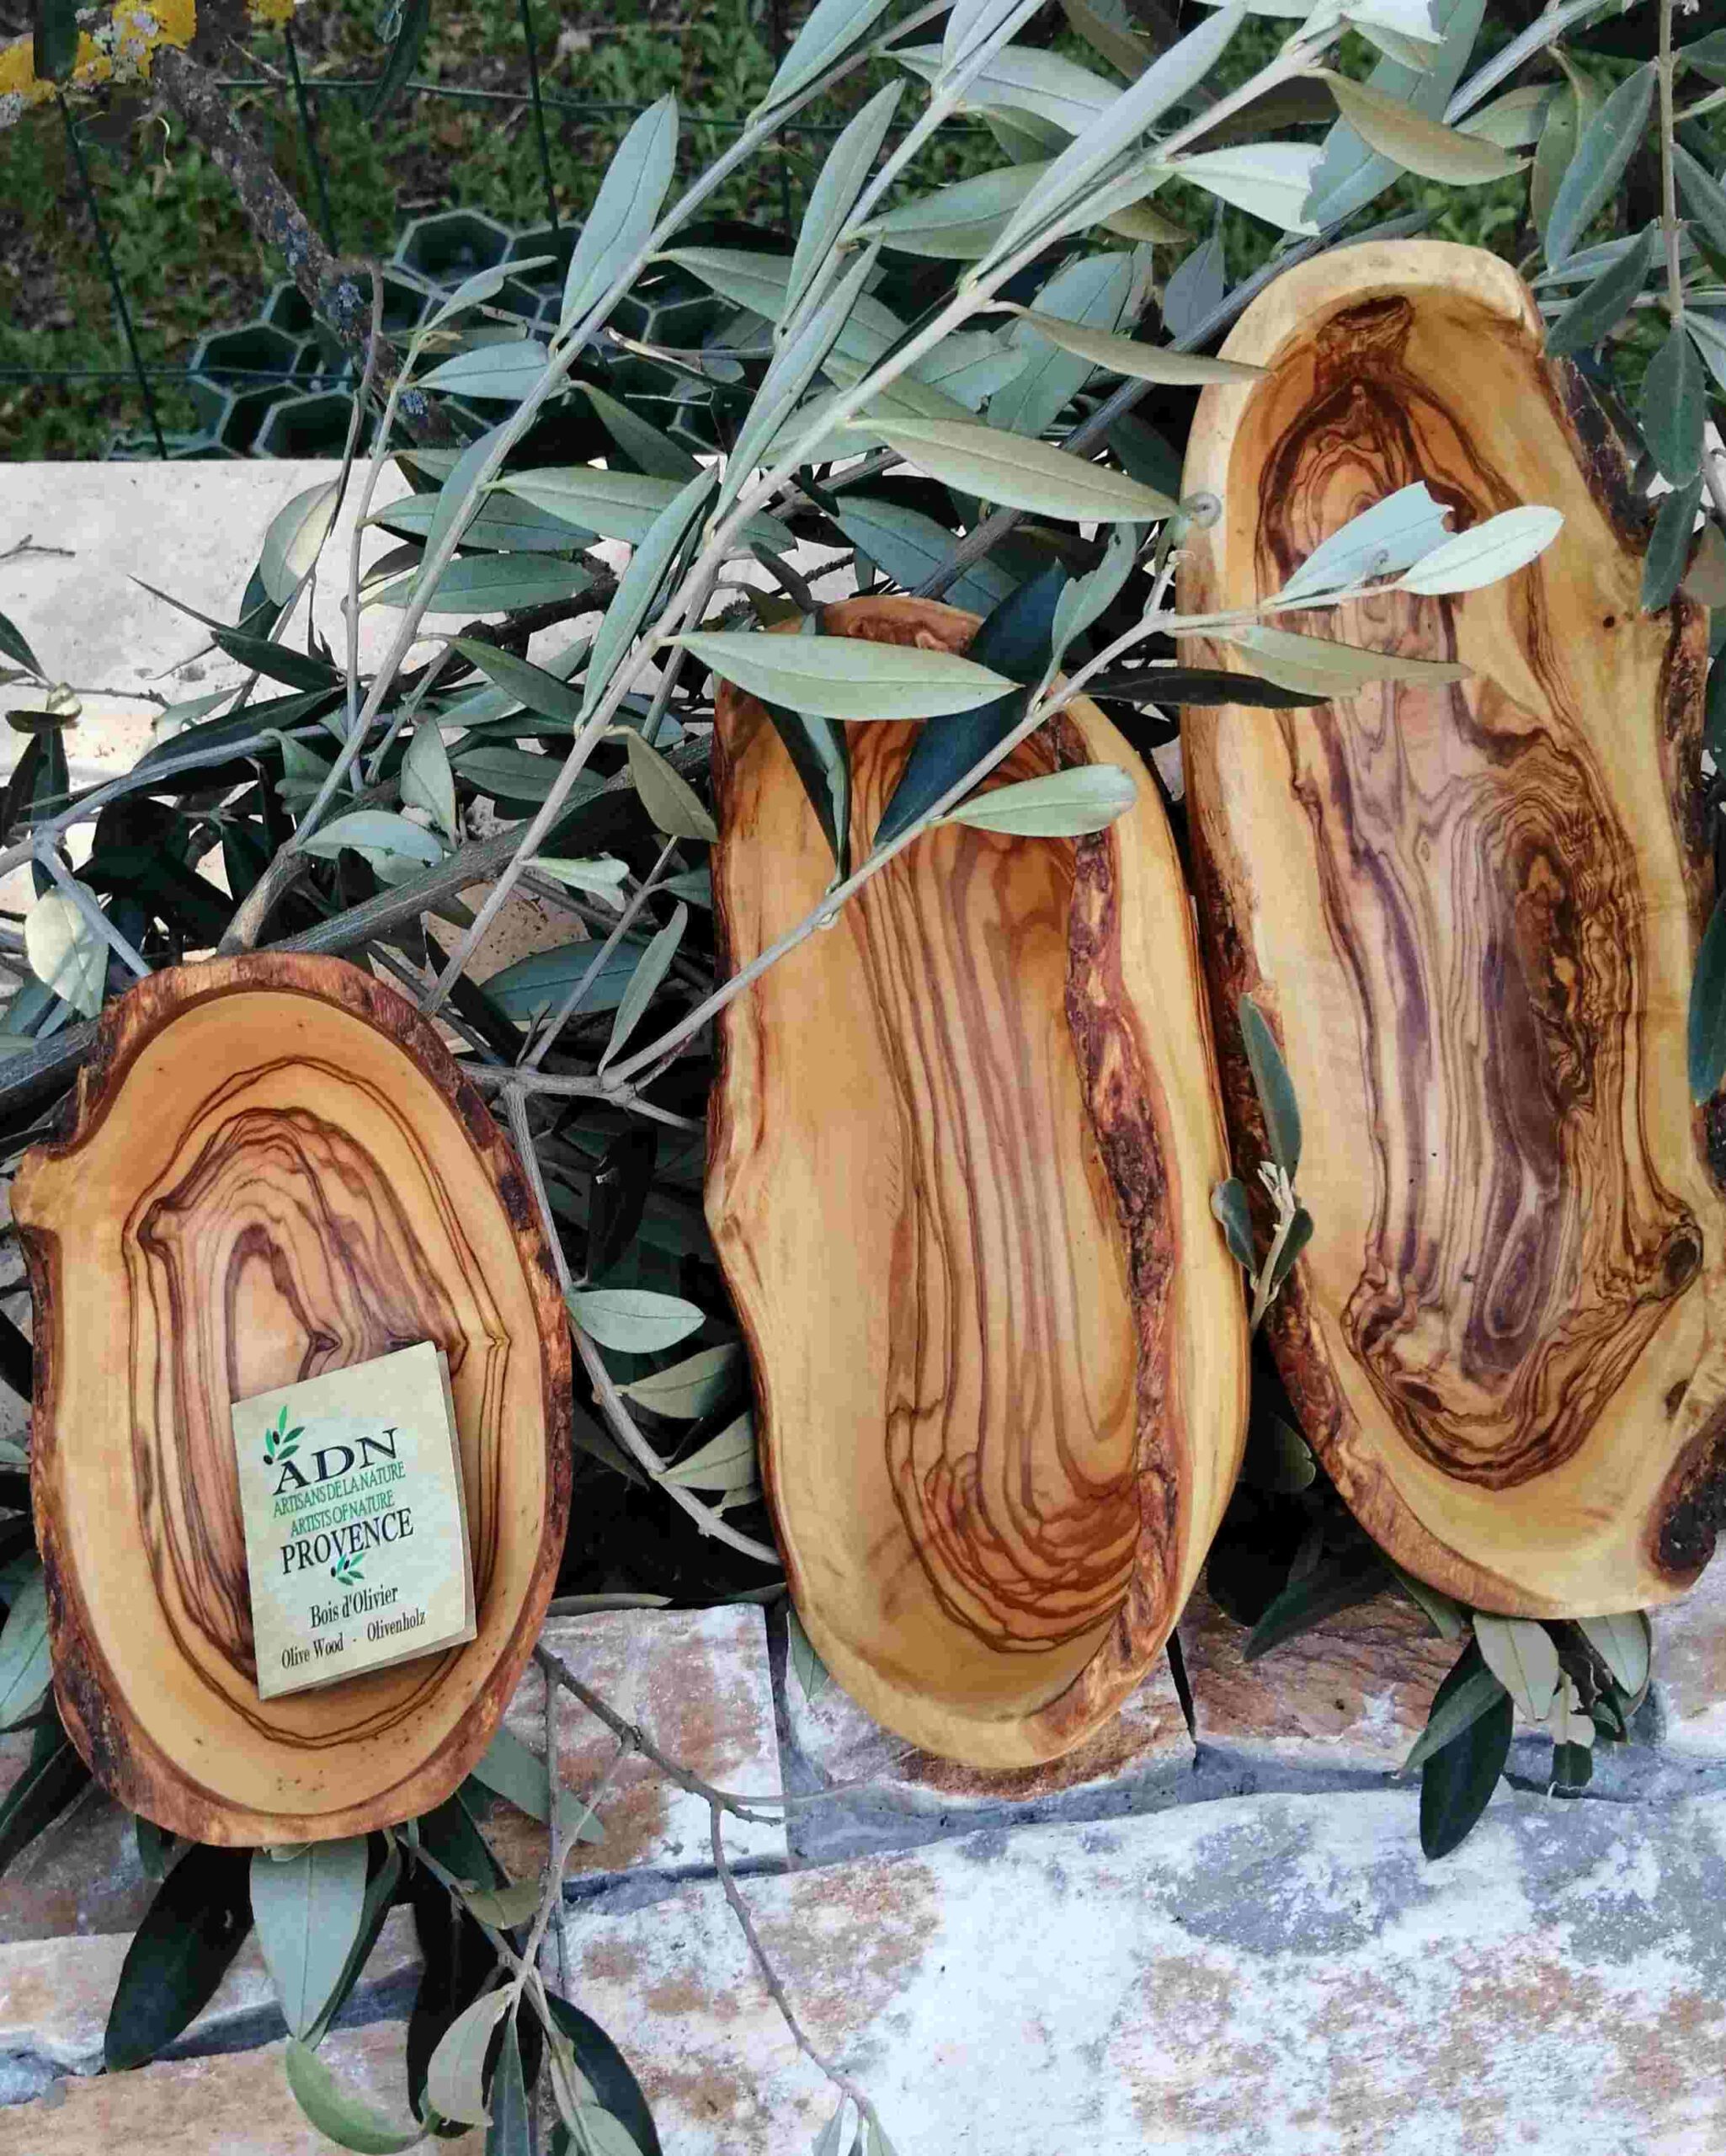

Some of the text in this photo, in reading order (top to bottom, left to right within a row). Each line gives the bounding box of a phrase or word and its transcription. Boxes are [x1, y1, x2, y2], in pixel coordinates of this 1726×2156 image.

[273, 1428, 398, 1496] ADN
[274, 1486, 327, 1518] ARTISANS
[360, 1461, 406, 1493] NATURE
[280, 1508, 413, 1575] PROVENCE
[291, 1510, 332, 1538] ARTISTS
[348, 1490, 395, 1518] NATURE
[309, 1584, 398, 1629] Bois d'Olivier
[281, 1646, 310, 1669] Olive
[313, 1632, 344, 1659] Wood
[367, 1608, 426, 1642] Olivenholz
